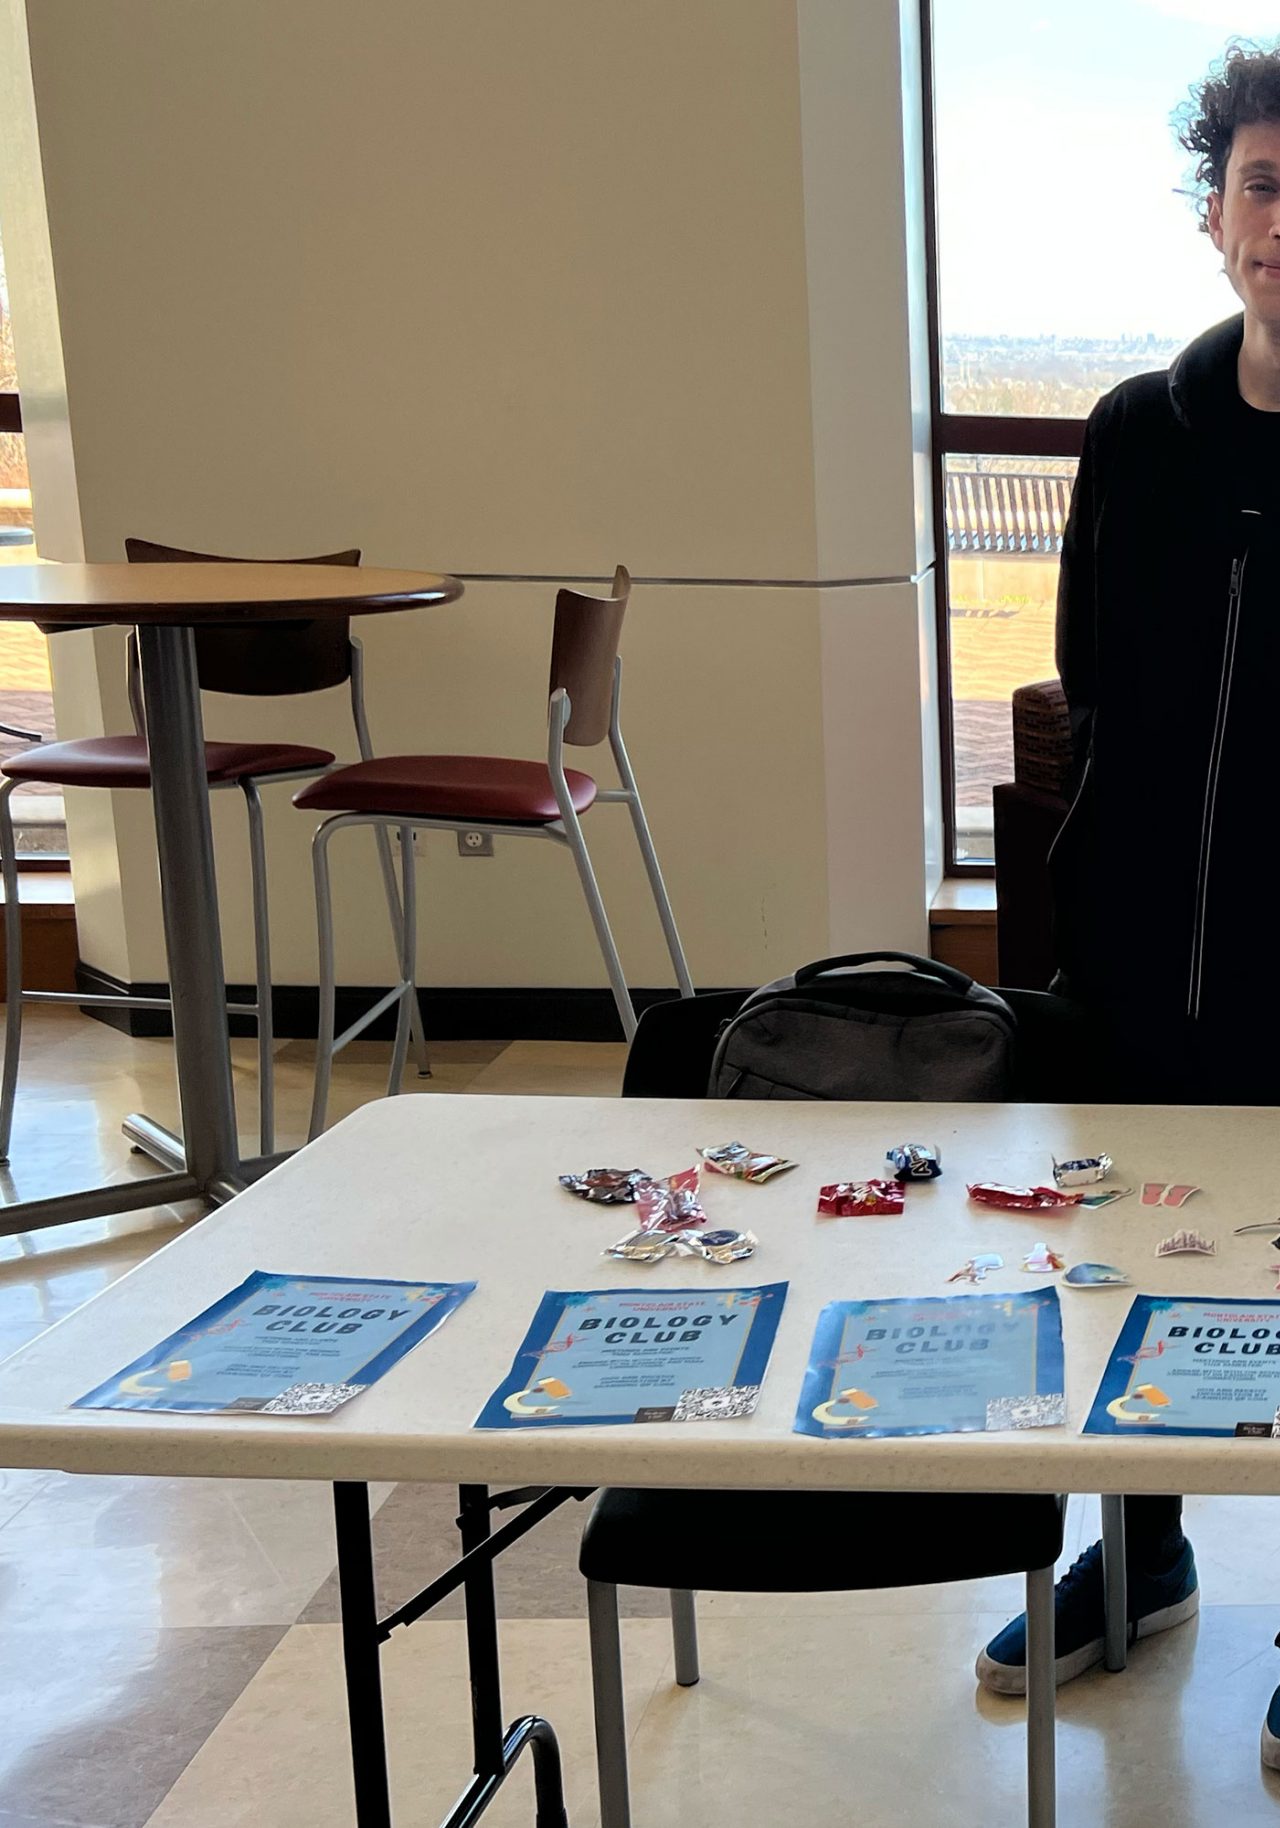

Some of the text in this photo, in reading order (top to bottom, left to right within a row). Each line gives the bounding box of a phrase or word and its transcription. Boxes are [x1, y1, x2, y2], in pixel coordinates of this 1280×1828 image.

[252, 1304, 411, 1321] BIOLOGY
[265, 1320, 363, 1334] CLUB
[578, 1314, 739, 1331] BIOLOGY
[604, 1330, 703, 1344] CLUB
[895, 1338, 990, 1354] CLUB
